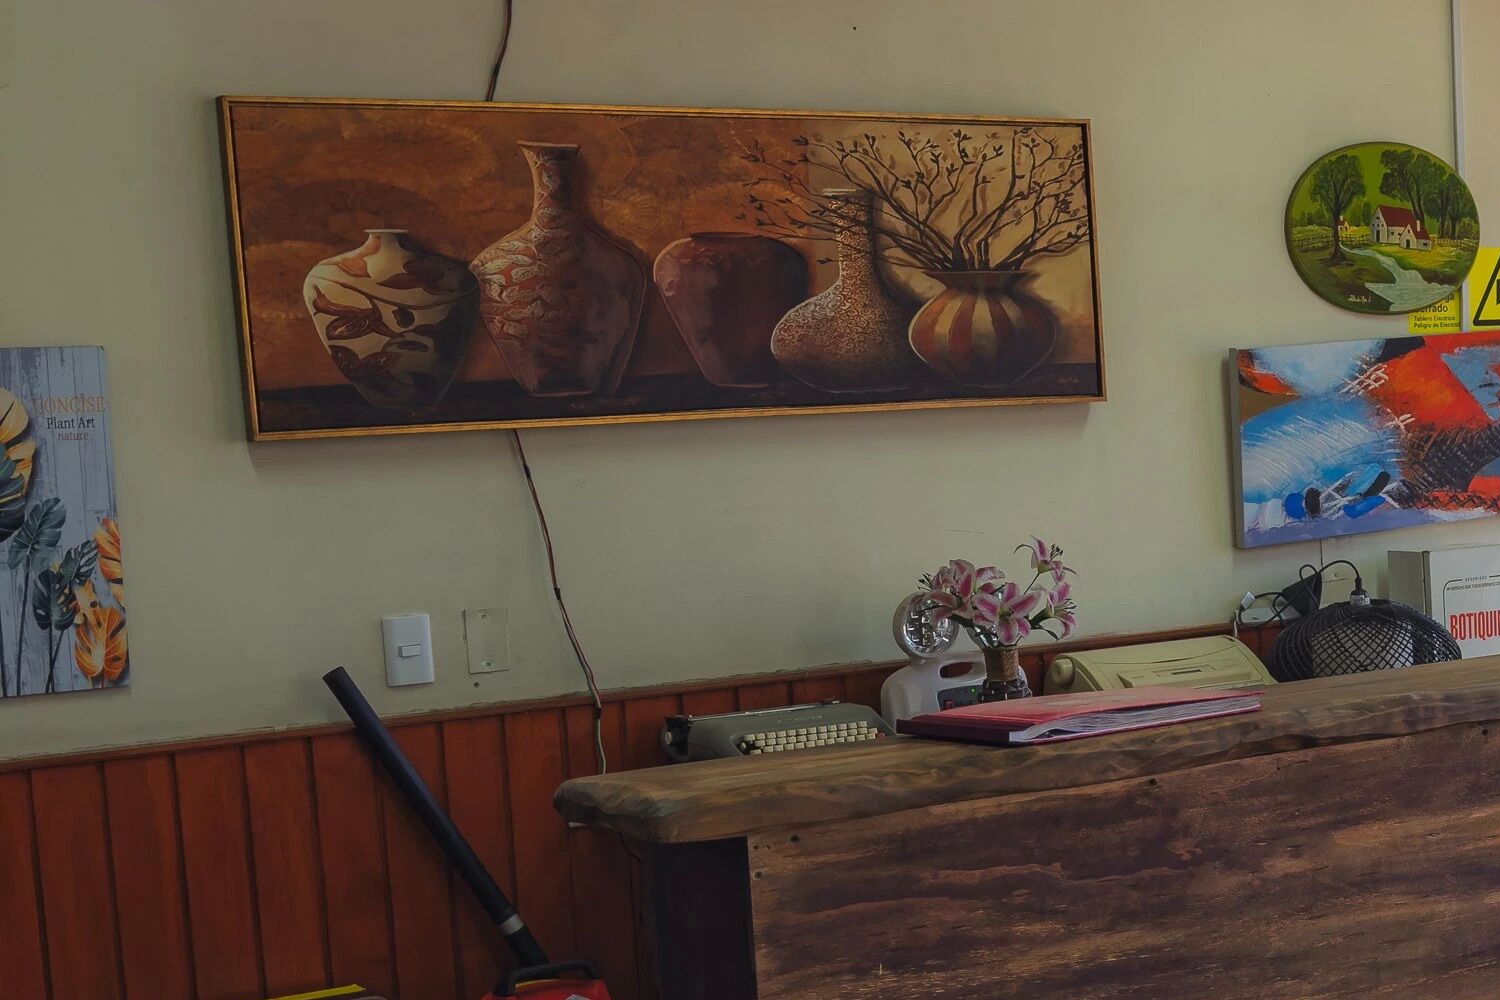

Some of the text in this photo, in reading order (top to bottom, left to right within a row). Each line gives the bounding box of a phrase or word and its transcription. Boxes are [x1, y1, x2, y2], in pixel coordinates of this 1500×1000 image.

[46, 416, 96, 429] Plant Art
[58, 431, 89, 441] nature
